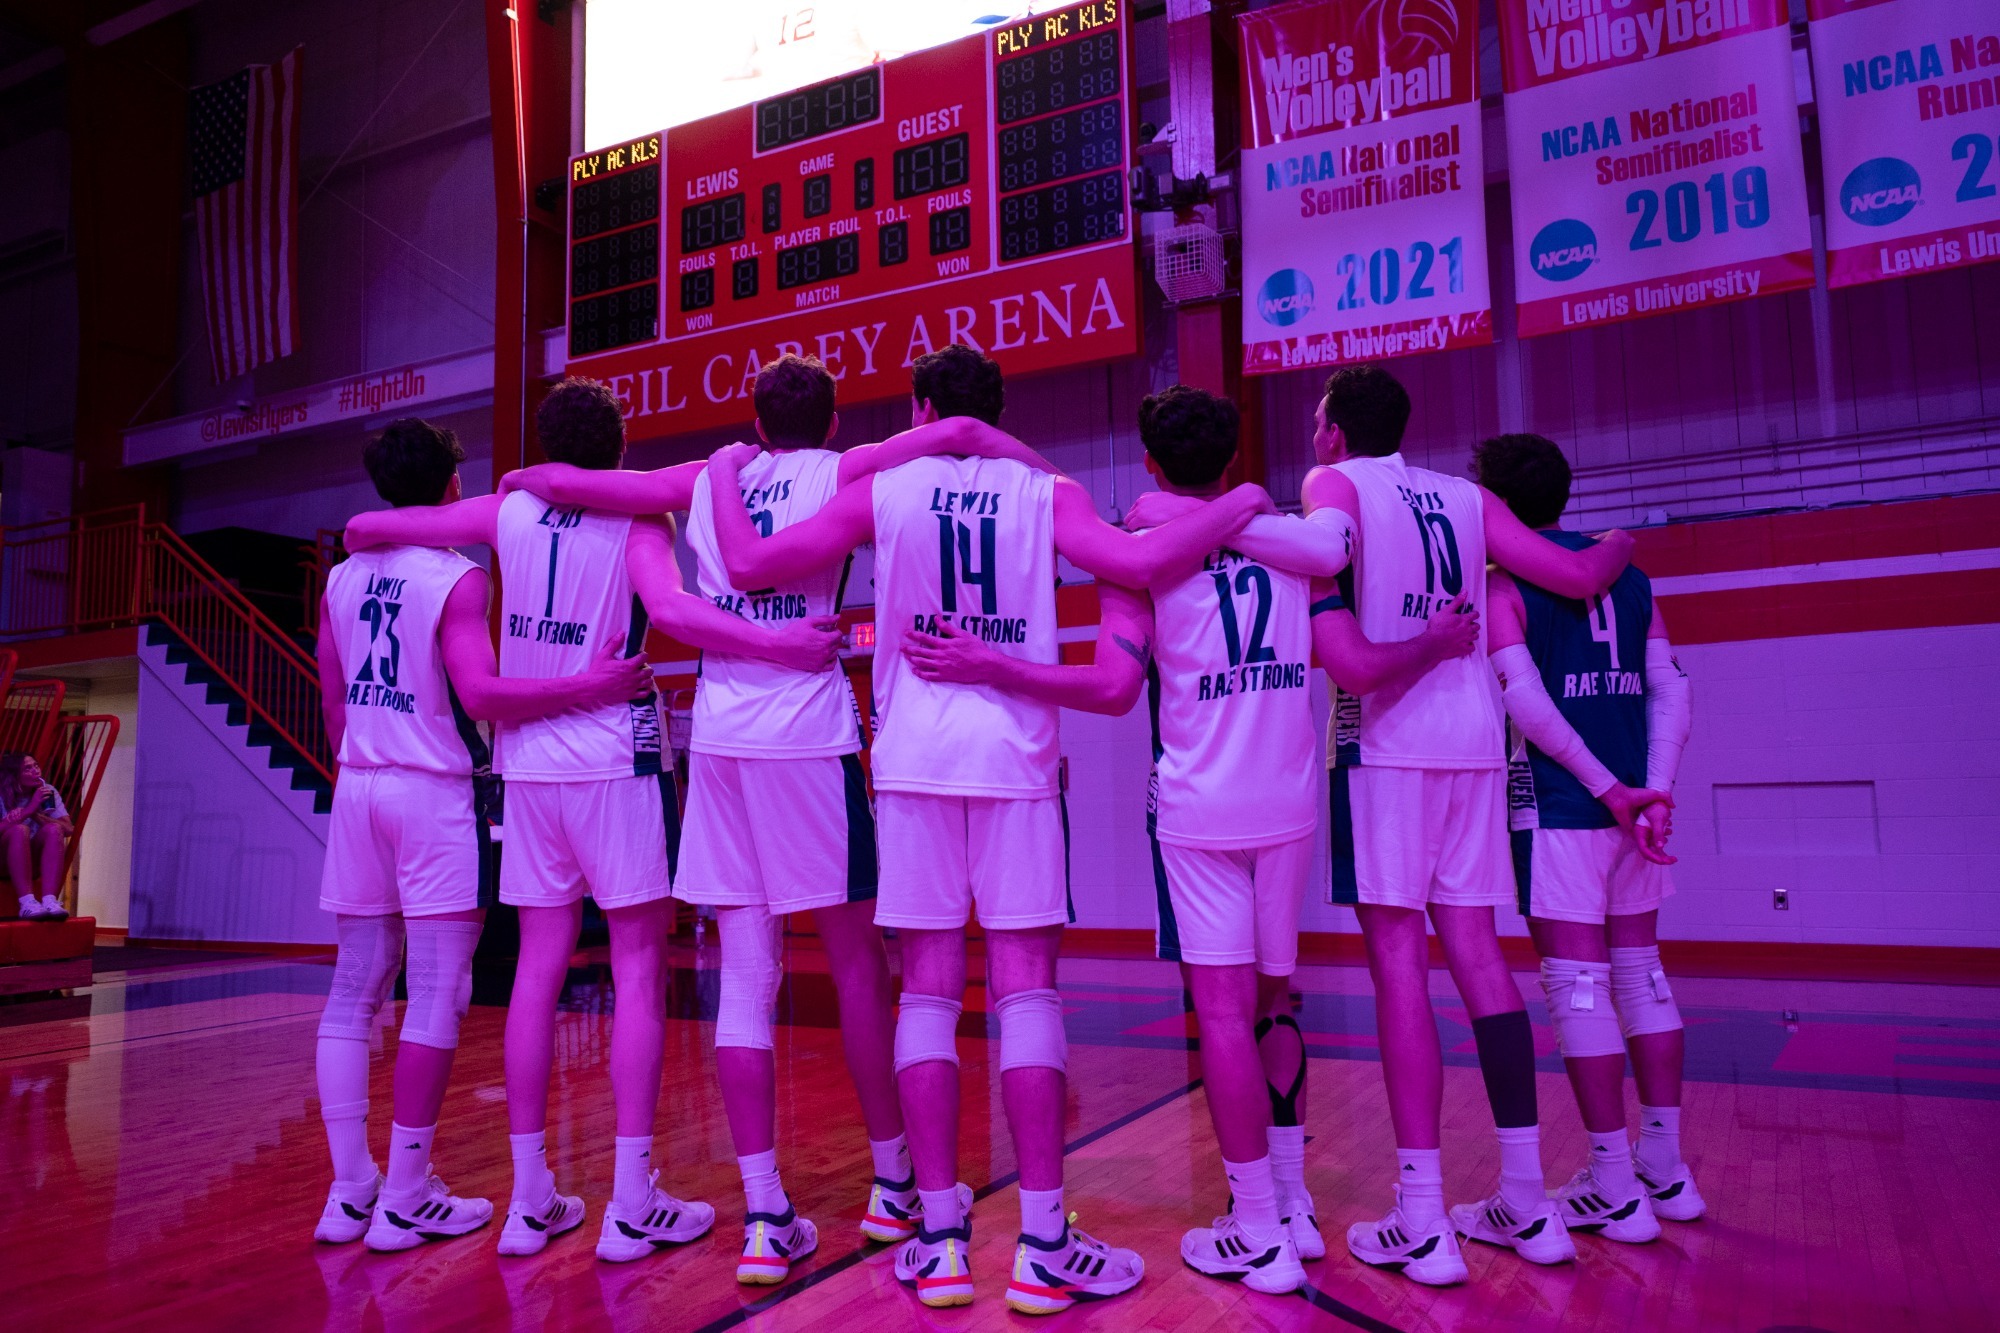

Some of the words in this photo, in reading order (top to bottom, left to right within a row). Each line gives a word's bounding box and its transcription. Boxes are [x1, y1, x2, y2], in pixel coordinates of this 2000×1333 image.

[778, 7, 816, 46] 12
[997, 24, 1033, 55] PLY
[1045, 13, 1069, 41] AC
[1079, 0, 1116, 31] KLS
[1526, 0, 1632, 31] Men
[1528, 0, 1751, 77] Volleyball
[1264, 42, 1354, 94] Men's
[1843, 43, 1944, 97] NCAA
[1265, 52, 1452, 136] Volleyball
[897, 104, 963, 142] GUEST
[1541, 116, 1622, 162] NCAA
[1629, 83, 1758, 143] National
[574, 155, 600, 181] PLY
[607, 148, 625, 171] AC
[631, 137, 659, 164] KLS
[800, 153, 835, 175] GAME
[1266, 150, 1336, 192] NCAA
[1341, 124, 1460, 177] Natonal
[1595, 123, 1764, 185] Semifinalist
[687, 168, 739, 200] LEWIS
[927, 189, 972, 213] FOULS
[1300, 160, 1461, 218] Semifinalist
[1850, 183, 1920, 215] NCAA
[875, 206, 911, 226] T.O.L.
[1626, 166, 1771, 250] 2019
[730, 243, 762, 261] T.O.L.
[774, 226, 821, 250] PLAYER
[829, 216, 862, 237] FOUL
[679, 252, 716, 274] FOULS
[937, 255, 970, 276] WON
[1336, 236, 1464, 311] 2021
[1537, 243, 1597, 271] NCAA
[1880, 237, 1962, 275] Lewis
[795, 284, 840, 308] MATCH
[1264, 292, 1315, 314] NCAA
[1562, 292, 1629, 326] Lewis
[1634, 269, 1761, 313] University
[686, 313, 713, 331] WON
[601, 364, 687, 420] EIL
[901, 277, 1124, 367] ARENA
[1281, 338, 1338, 368] Lewis
[1343, 325, 1449, 359] University
[338, 367, 425, 413] #FlightOn
[929, 487, 1002, 515] LEWIS
[935, 513, 998, 615] 14
[1408, 503, 1463, 596] 10
[364, 573, 408, 600] LEWIS
[544, 531, 560, 618] 1
[1209, 565, 1277, 668] 12
[1401, 593, 1431, 621] RAE
[355, 597, 402, 688] 23
[535, 619, 588, 647] STRONG
[856, 624, 875, 646] EX
[960, 615, 1027, 644] STRONG
[1585, 587, 1621, 669] 4
[371, 684, 415, 714] TRONG
[1197, 669, 1236, 701] RAE
[1240, 663, 1305, 693] STRONG
[1563, 671, 1599, 698] RAE
[630, 704, 660, 752] FLYERS
[1509, 761, 1536, 811] FLYERS
